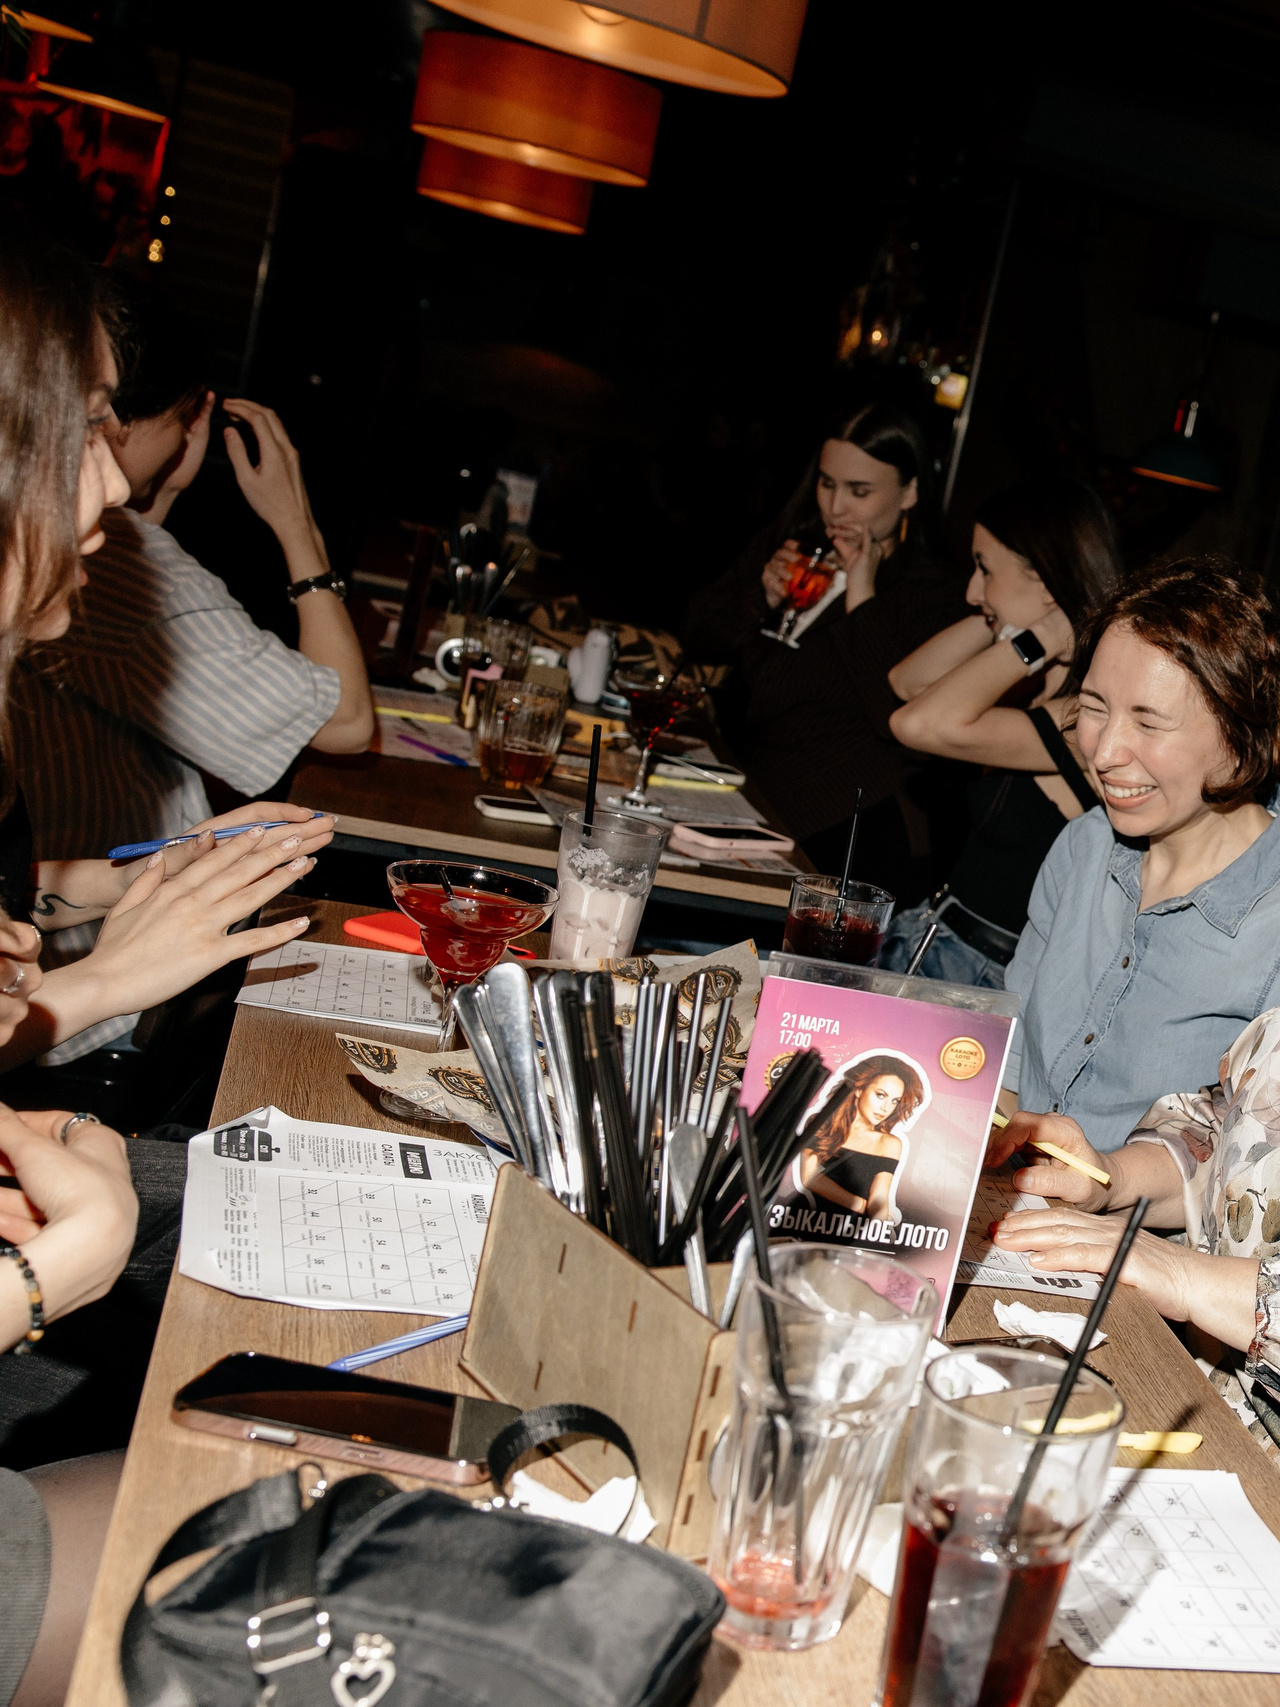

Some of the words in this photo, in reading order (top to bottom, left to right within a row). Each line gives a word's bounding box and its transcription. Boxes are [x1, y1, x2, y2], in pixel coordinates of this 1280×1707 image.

[780, 1012, 797, 1028] 21
[798, 1014, 840, 1036] МАРТА
[779, 1029, 812, 1048] 17:00
[950, 1048, 978, 1057] KARAOKE
[955, 1053, 971, 1061] LOTO
[381, 1143, 396, 1167] САЛАТЫ
[405, 1151, 424, 1175] МЕНЮ
[764, 1203, 896, 1244] ЗЫКАЛЬНОЕ
[894, 1222, 950, 1252] ЛОТО
